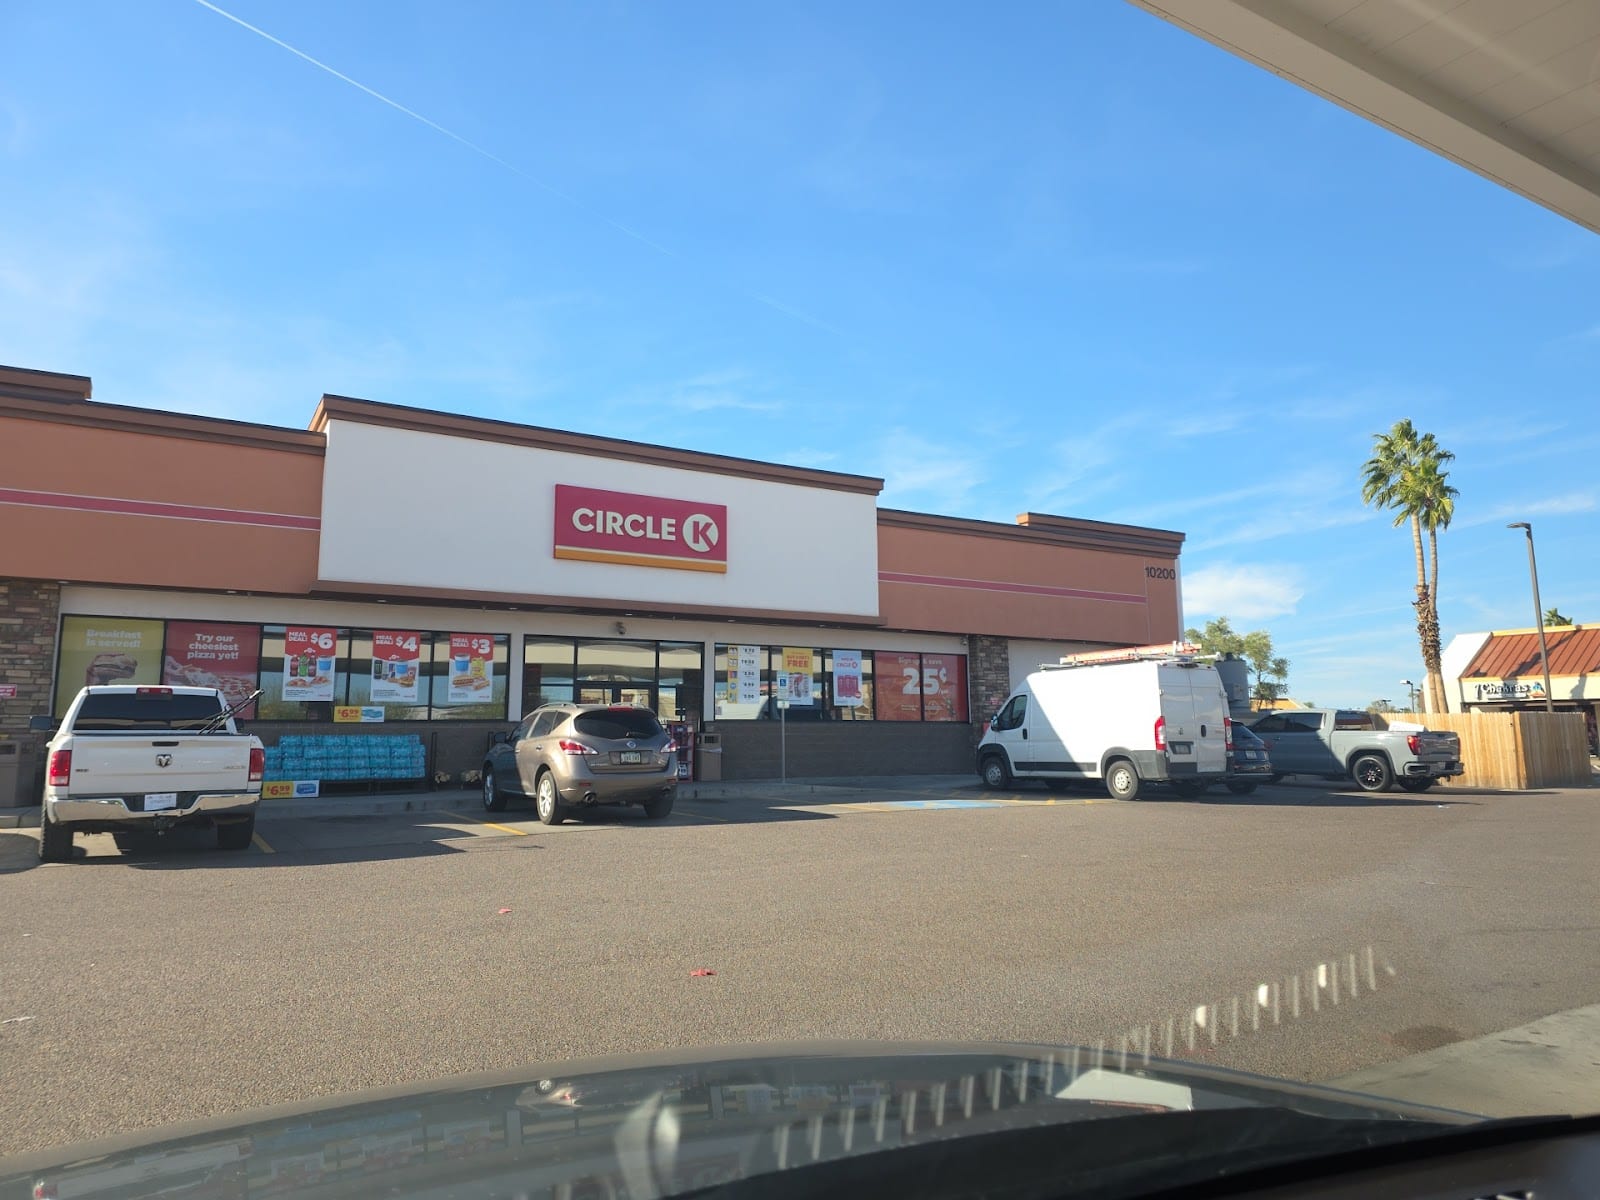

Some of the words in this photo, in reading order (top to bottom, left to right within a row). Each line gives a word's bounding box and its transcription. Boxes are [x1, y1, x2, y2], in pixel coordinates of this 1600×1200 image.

[572, 507, 676, 541] CIRCLE
[686, 515, 719, 552] K
[1145, 566, 1176, 580] 10200
[195, 633, 213, 642] Try
[311, 632, 333, 649] $6
[395, 635, 417, 652] $4
[188, 642, 239, 650] cheesiest
[472, 638, 490, 654] $3
[187, 650, 216, 660] pizza
[218, 651, 239, 660] yet!
[787, 660, 808, 668] FREE
